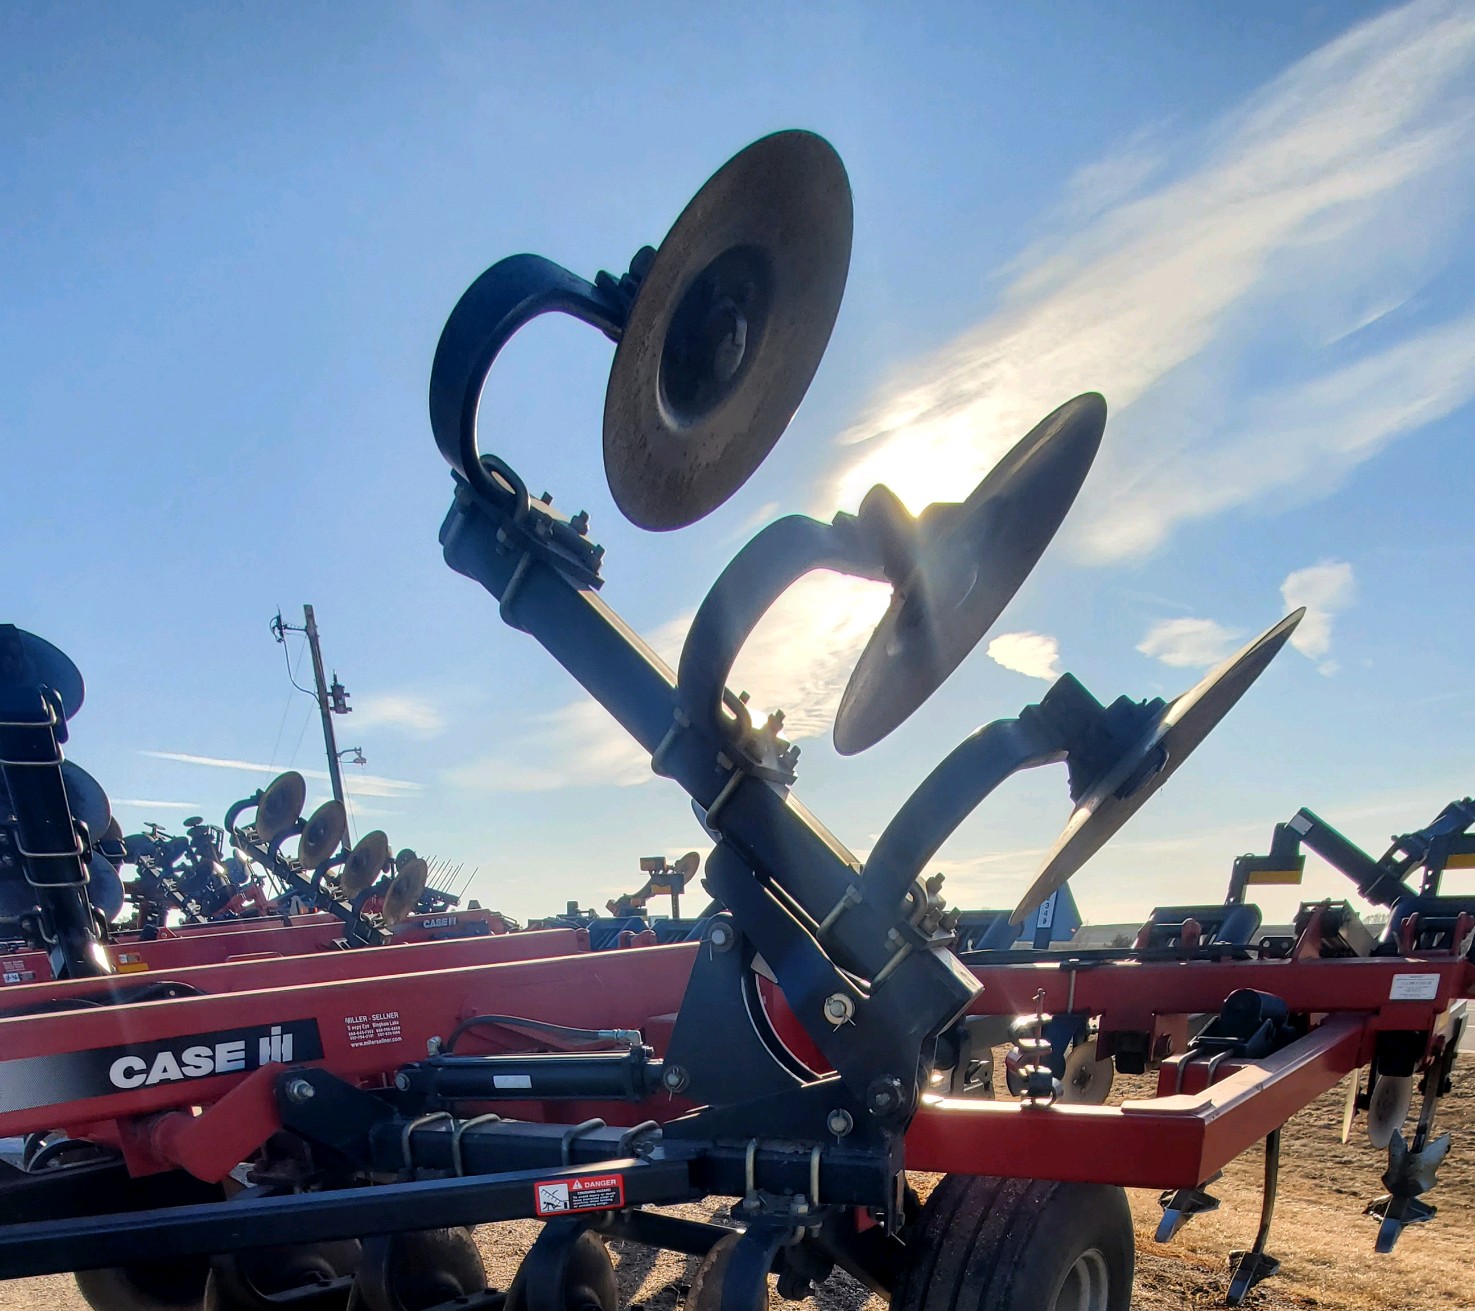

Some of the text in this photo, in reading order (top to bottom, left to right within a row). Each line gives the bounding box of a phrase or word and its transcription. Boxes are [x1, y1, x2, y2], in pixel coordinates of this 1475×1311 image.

[423, 917, 448, 928] CASE
[372, 1012, 398, 1020] SELLNER
[109, 1040, 246, 1089] CASE
[584, 1179, 616, 1188] DANGER
